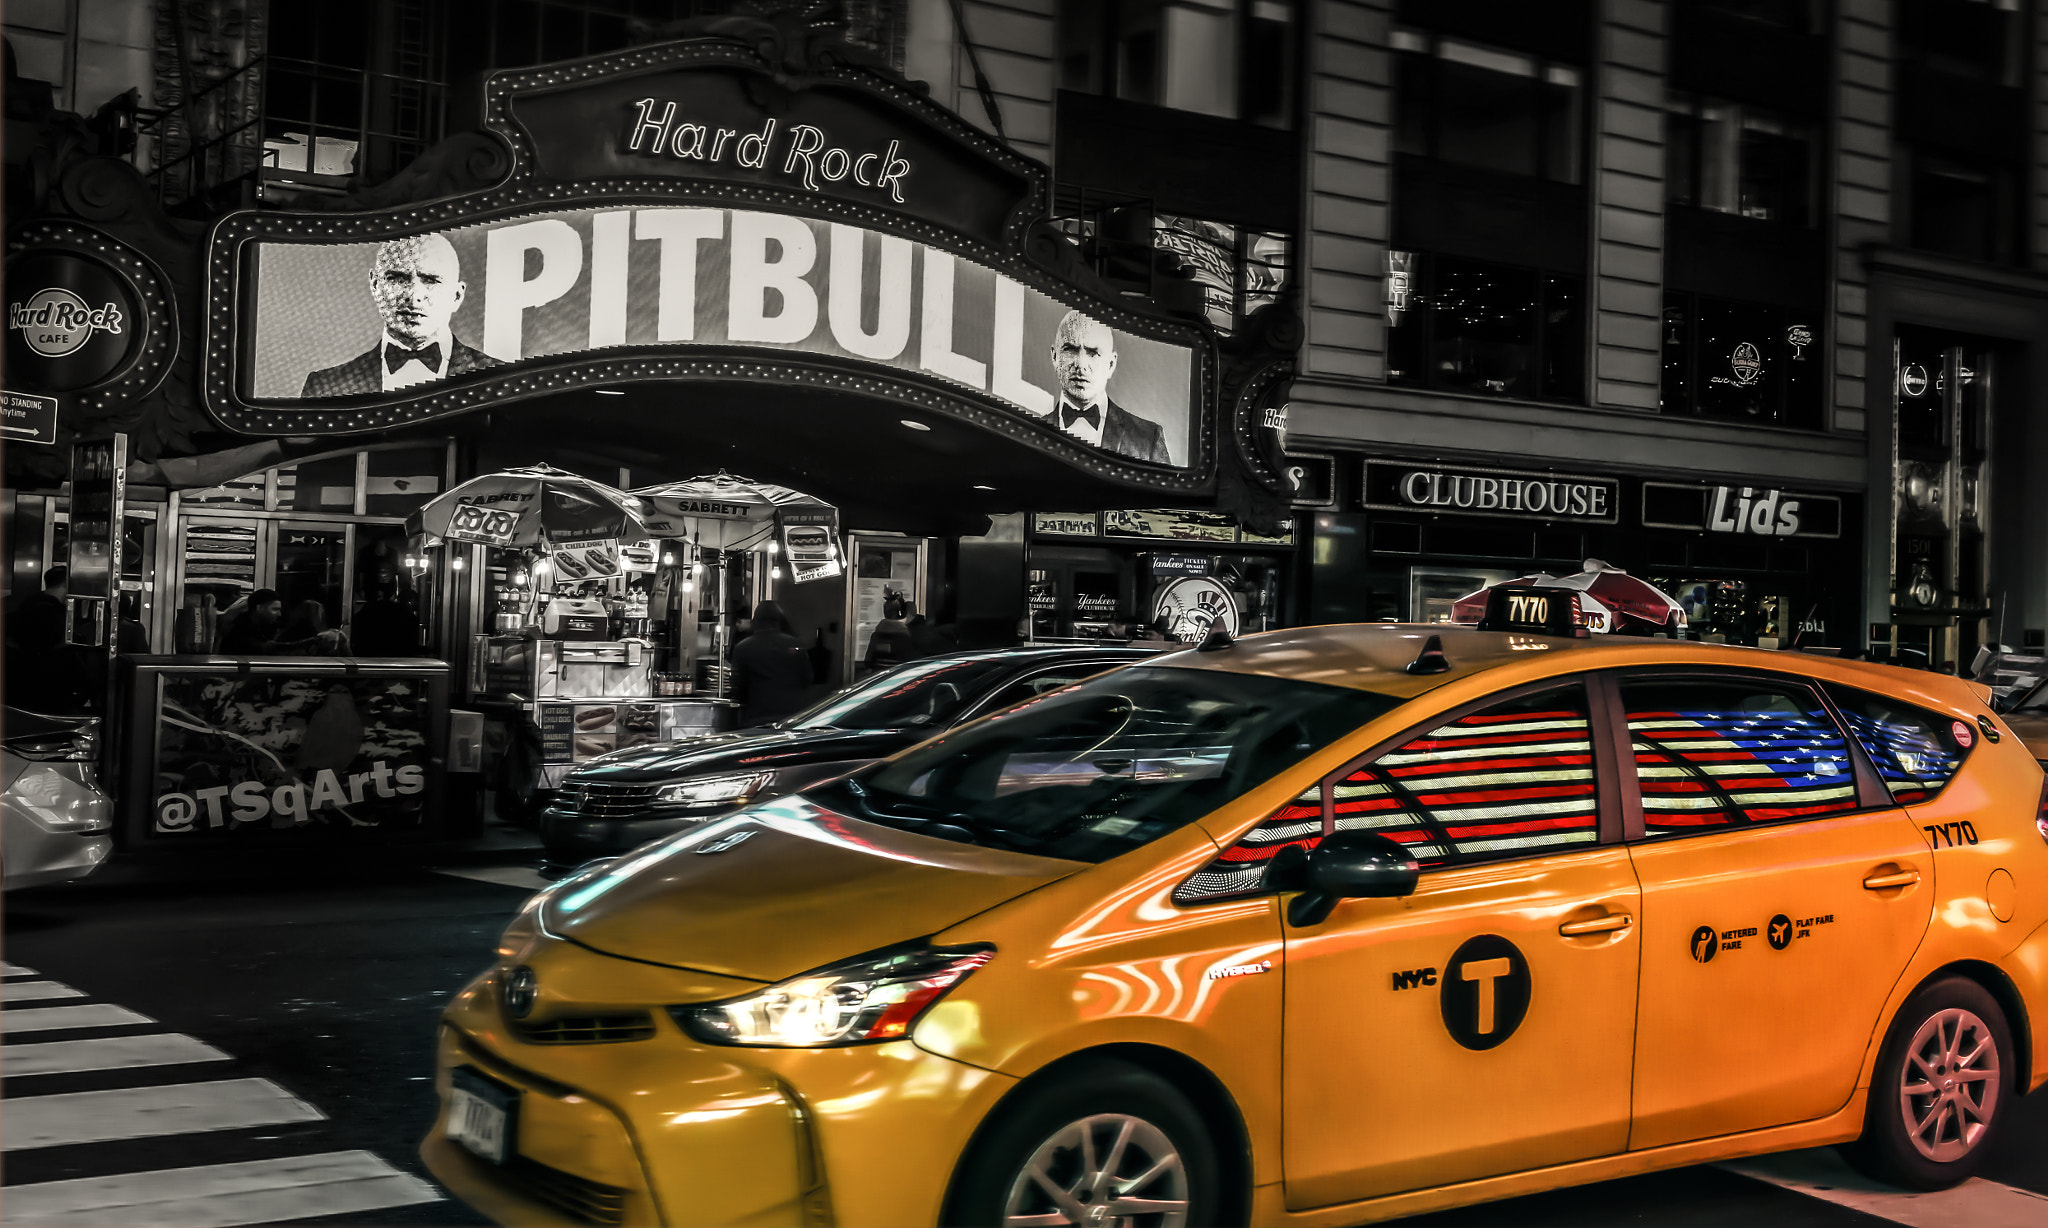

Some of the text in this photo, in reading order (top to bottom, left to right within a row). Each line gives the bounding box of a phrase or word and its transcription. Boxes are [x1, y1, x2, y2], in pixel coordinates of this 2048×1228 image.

[629, 98, 911, 203] Hard Rock
[10, 301, 123, 334] Hard Rock
[483, 207, 1056, 417] PITBULL
[38, 334, 69, 344] CAFE
[10, 397, 42, 410] STANDING
[1263, 408, 1287, 431] Har
[1405, 472, 1609, 517] CLUBHOUSE
[678, 500, 750, 516] SABRETT
[1706, 486, 1799, 535] Lids
[1907, 538, 1932, 554] 1501
[1077, 593, 1116, 611] Yankees
[1509, 596, 1548, 624] 7Y70
[156, 761, 425, 833] @TSqArts
[1924, 820, 1979, 849] 7Y70
[1795, 914, 1834, 928] FLAT FARE
[1721, 927, 1758, 940] METERED
[1796, 929, 1811, 939] JFK
[1721, 940, 1742, 951] FARE
[1392, 956, 1511, 1035] NYC T
